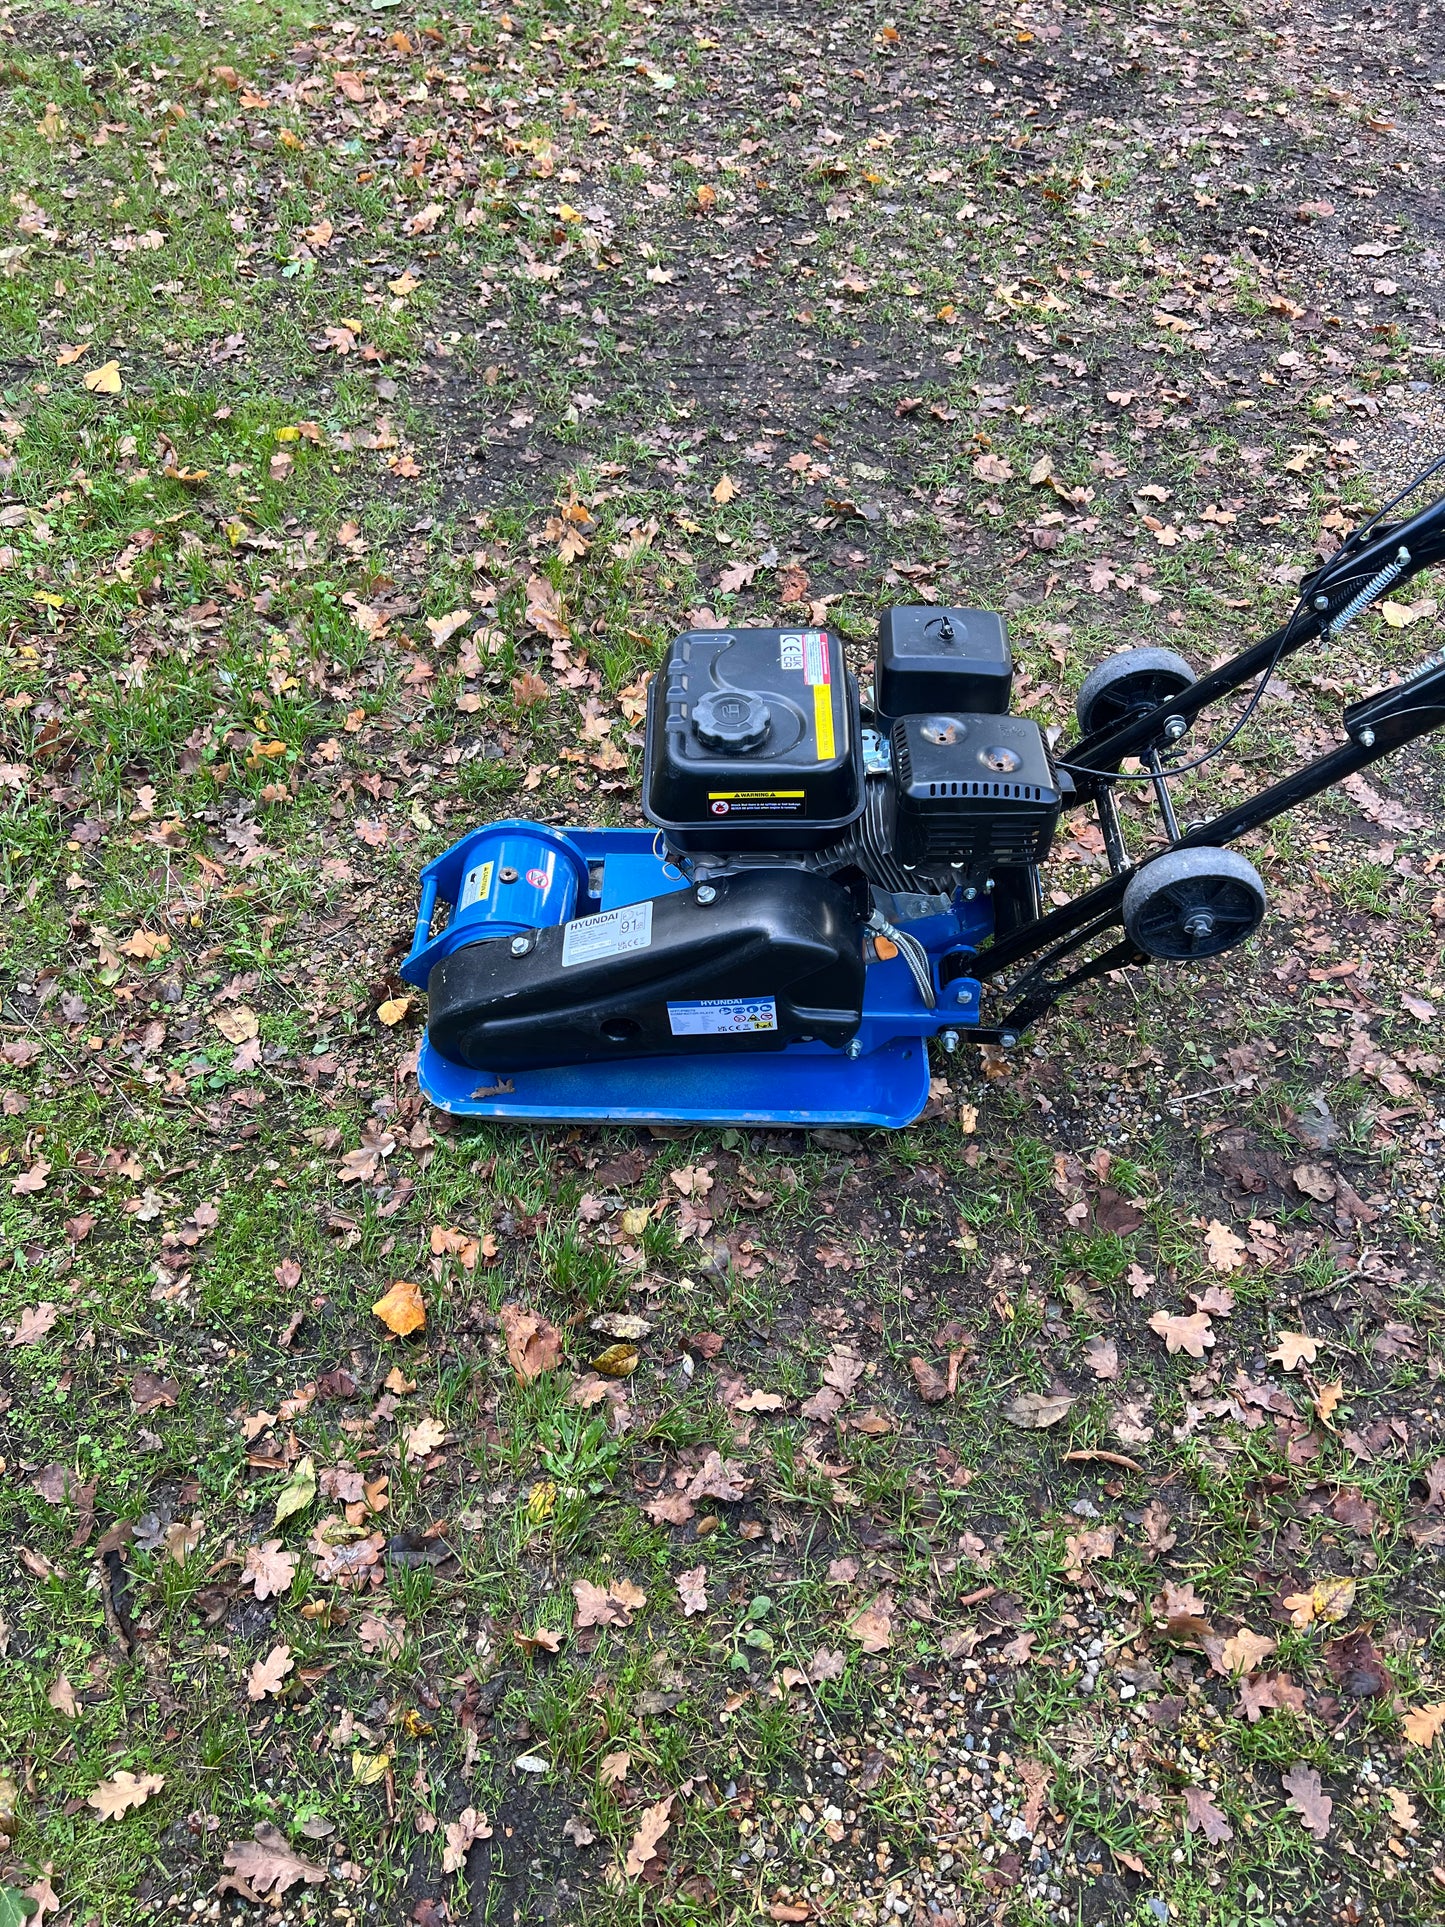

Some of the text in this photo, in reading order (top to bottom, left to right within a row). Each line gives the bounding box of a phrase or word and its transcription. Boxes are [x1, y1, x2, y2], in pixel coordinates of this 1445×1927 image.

[782, 636, 801, 653] CE
[783, 656, 792, 667] CA
[794, 656, 802, 667] UK
[570, 913, 618, 930] HYUNDAI
[621, 919, 636, 934] 91
[700, 999, 743, 1007] HYUNDAI
